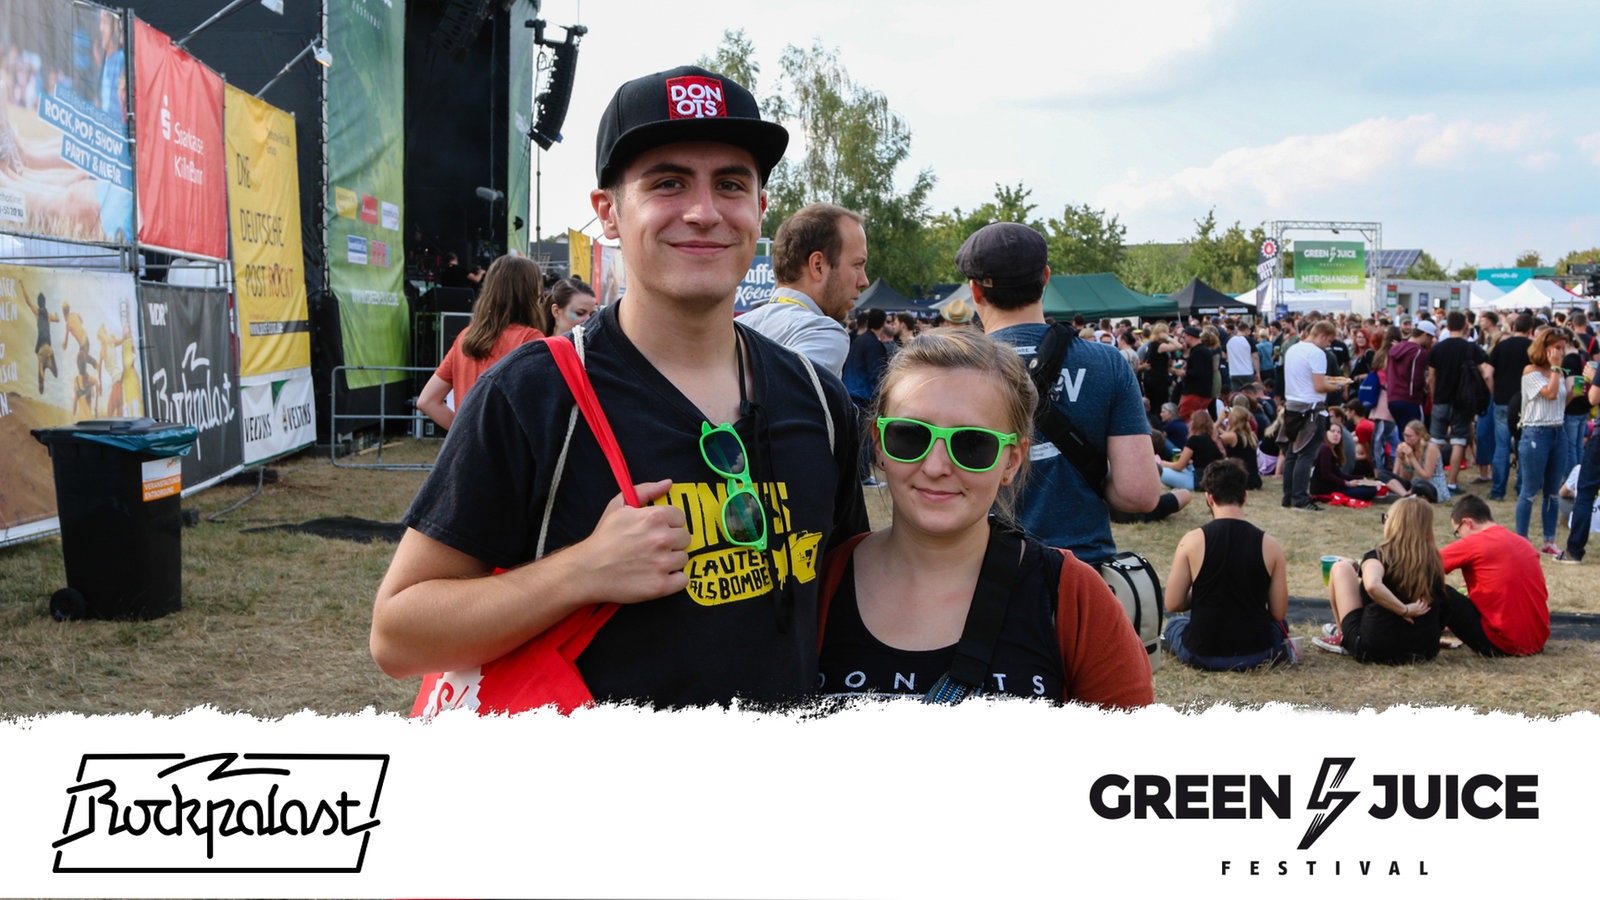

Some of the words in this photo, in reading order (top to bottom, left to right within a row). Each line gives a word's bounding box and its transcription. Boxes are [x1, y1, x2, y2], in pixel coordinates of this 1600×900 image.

[671, 84, 722, 102] DON
[676, 99, 718, 118] OTS
[95, 130, 123, 155] SHOW
[65, 139, 91, 168] PARTY
[92, 156, 99, 174] &
[240, 208, 284, 247] DEUTSCHE
[1303, 249, 1329, 258] GREEN
[1337, 249, 1357, 258] JUICE
[245, 264, 266, 297] POST
[742, 263, 776, 285] affe
[1301, 275, 1360, 284] MERCHANDISE
[287, 403, 311, 431] VELTINS
[690, 580, 717, 600] ALS
[818, 671, 1045, 695] ONTS
